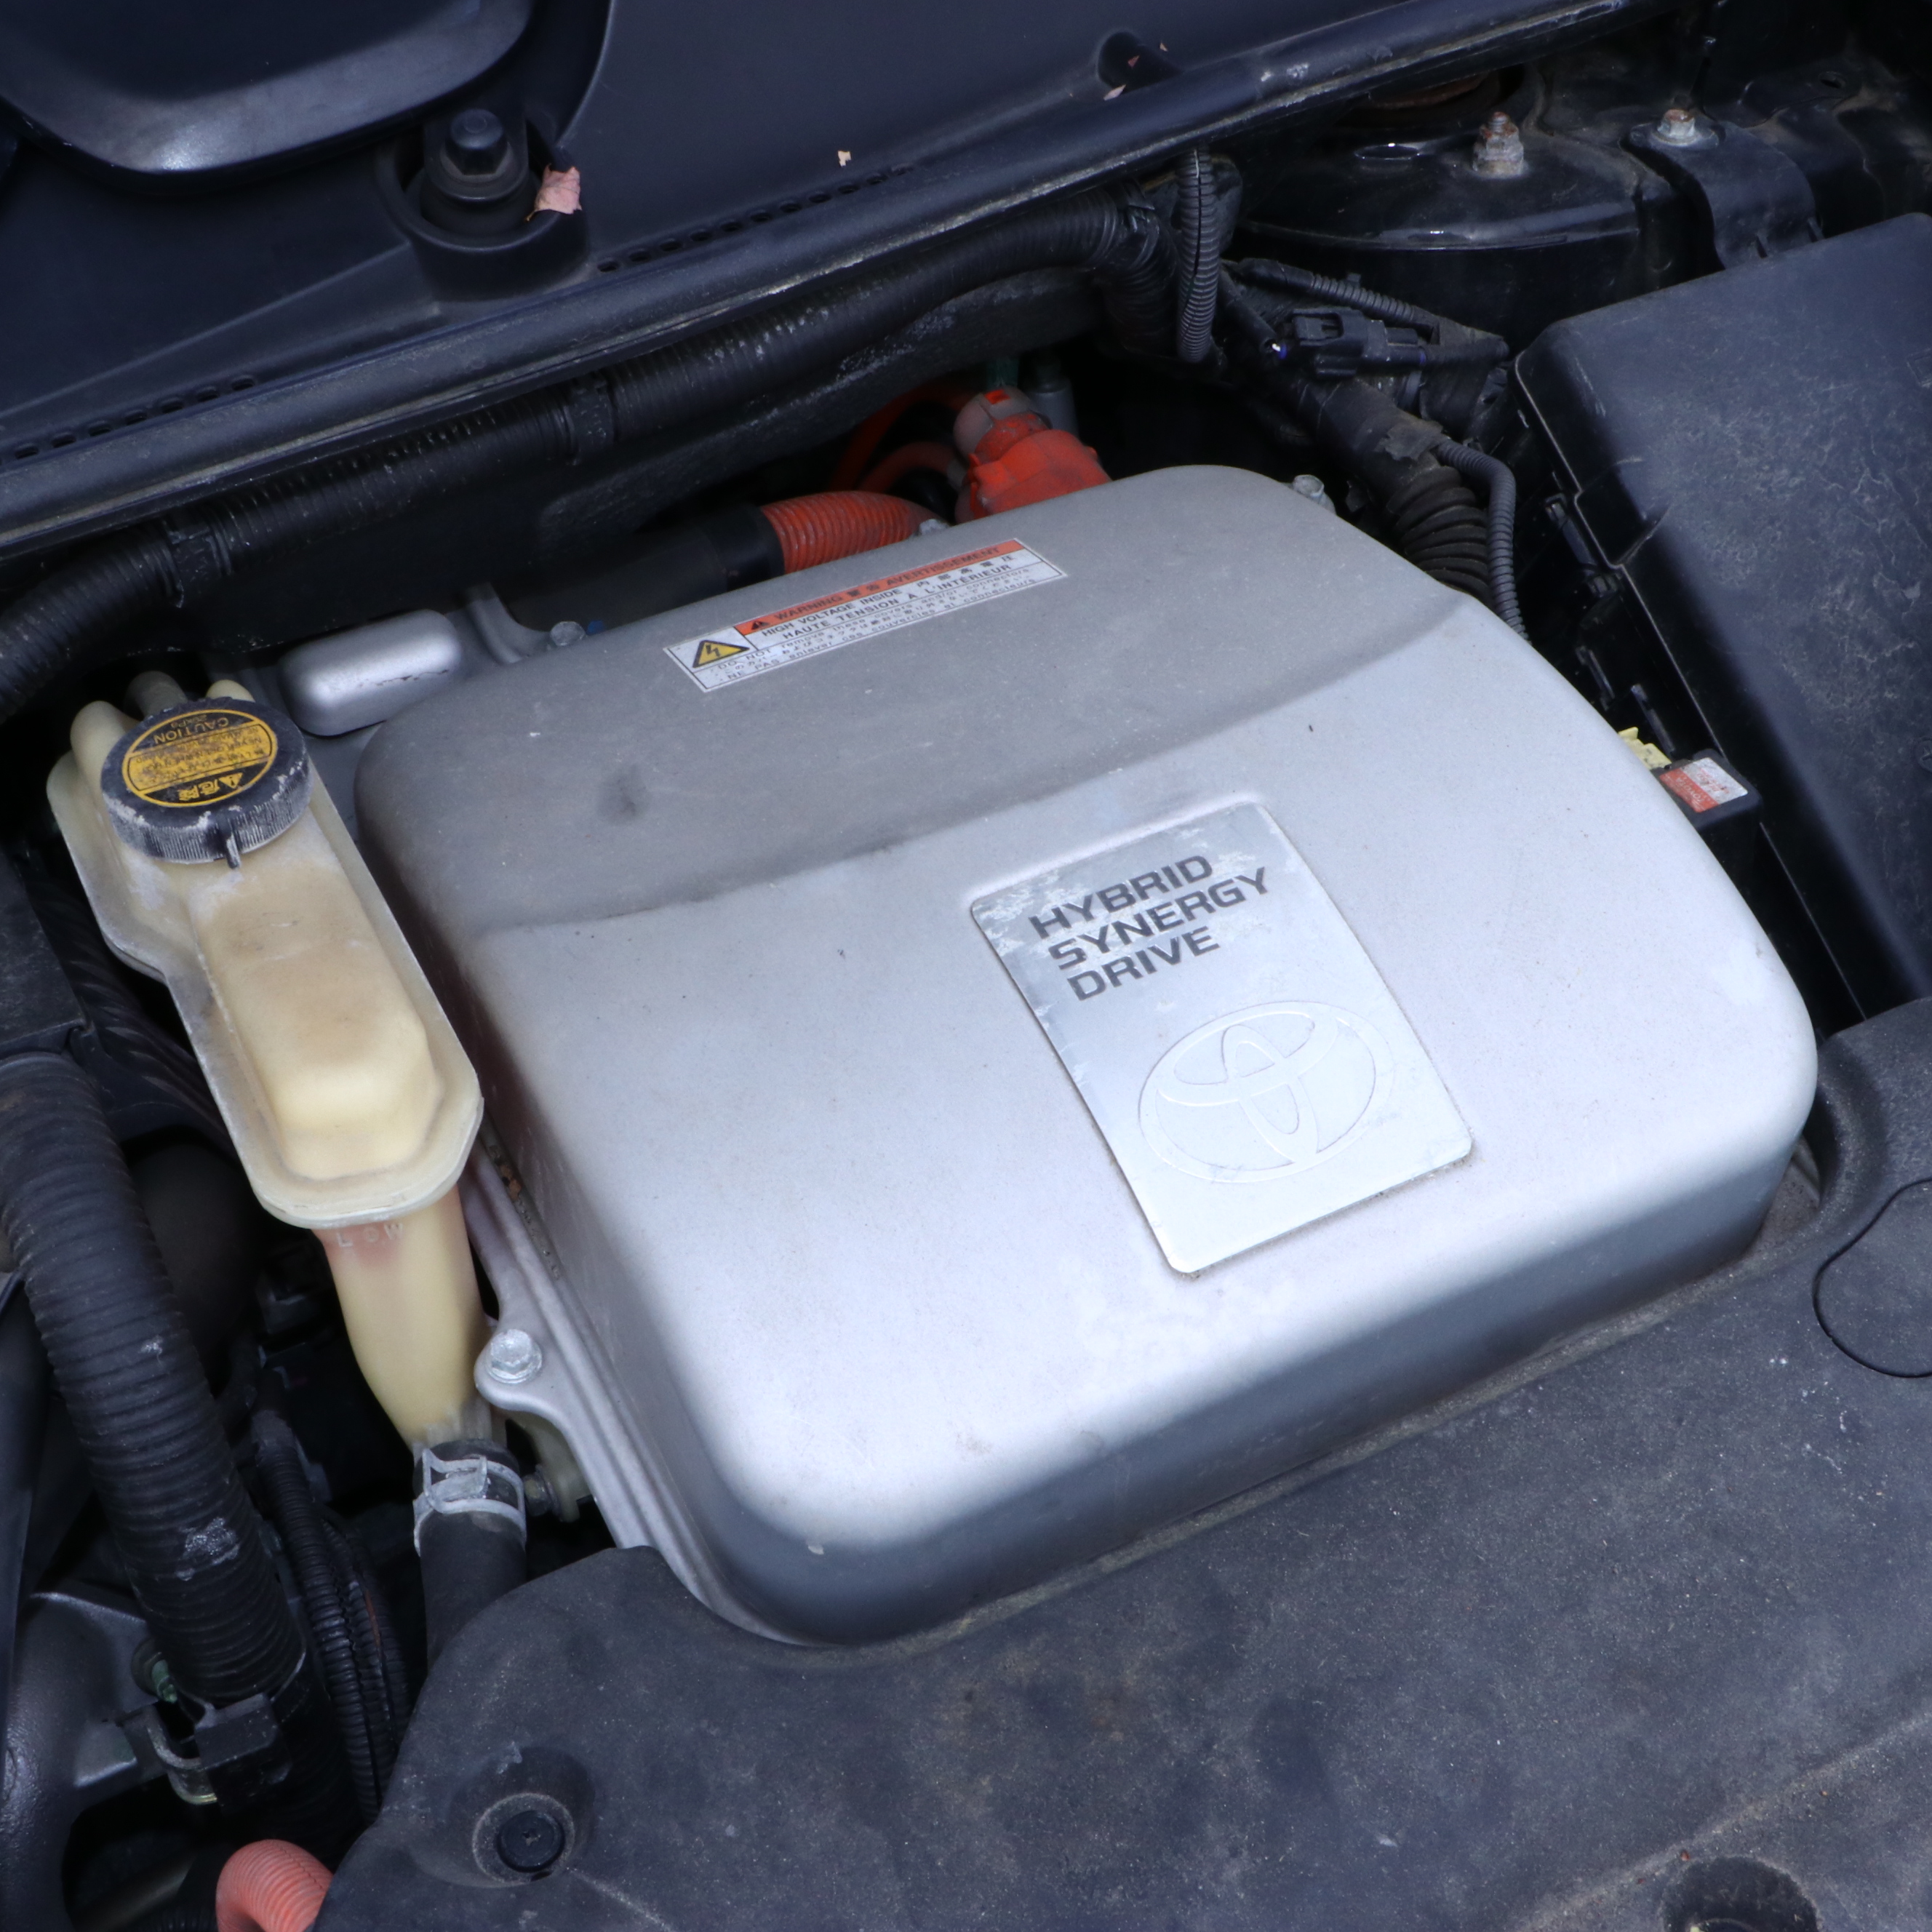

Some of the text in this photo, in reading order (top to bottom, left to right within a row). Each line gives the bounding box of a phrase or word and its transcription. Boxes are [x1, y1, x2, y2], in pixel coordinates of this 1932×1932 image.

[882, 548, 1002, 586] AVERTISSEMENT
[716, 659, 738, 669] DO
[744, 648, 772, 660] NOT
[779, 633, 826, 648] remove
[831, 619, 867, 631] these
[872, 604, 914, 618] covers
[964, 568, 1030, 591] connectors
[759, 589, 903, 636] HIGH VOLTAGE INSIDE
[773, 596, 845, 620] WARNING
[781, 621, 832, 639] HAUTE
[836, 599, 901, 621] TENSION
[922, 564, 1013, 594] L'INTÉRIEUR
[725, 669, 746, 679] NE
[753, 658, 781, 670] PAS
[153, 717, 230, 744] CAUTION
[178, 779, 221, 801] 危険
[1029, 855, 1213, 939] HYBRID
[1048, 866, 1269, 970] SYNERGY
[1067, 926, 1221, 1001] DRIVE
[335, 1222, 404, 1248] LOW
